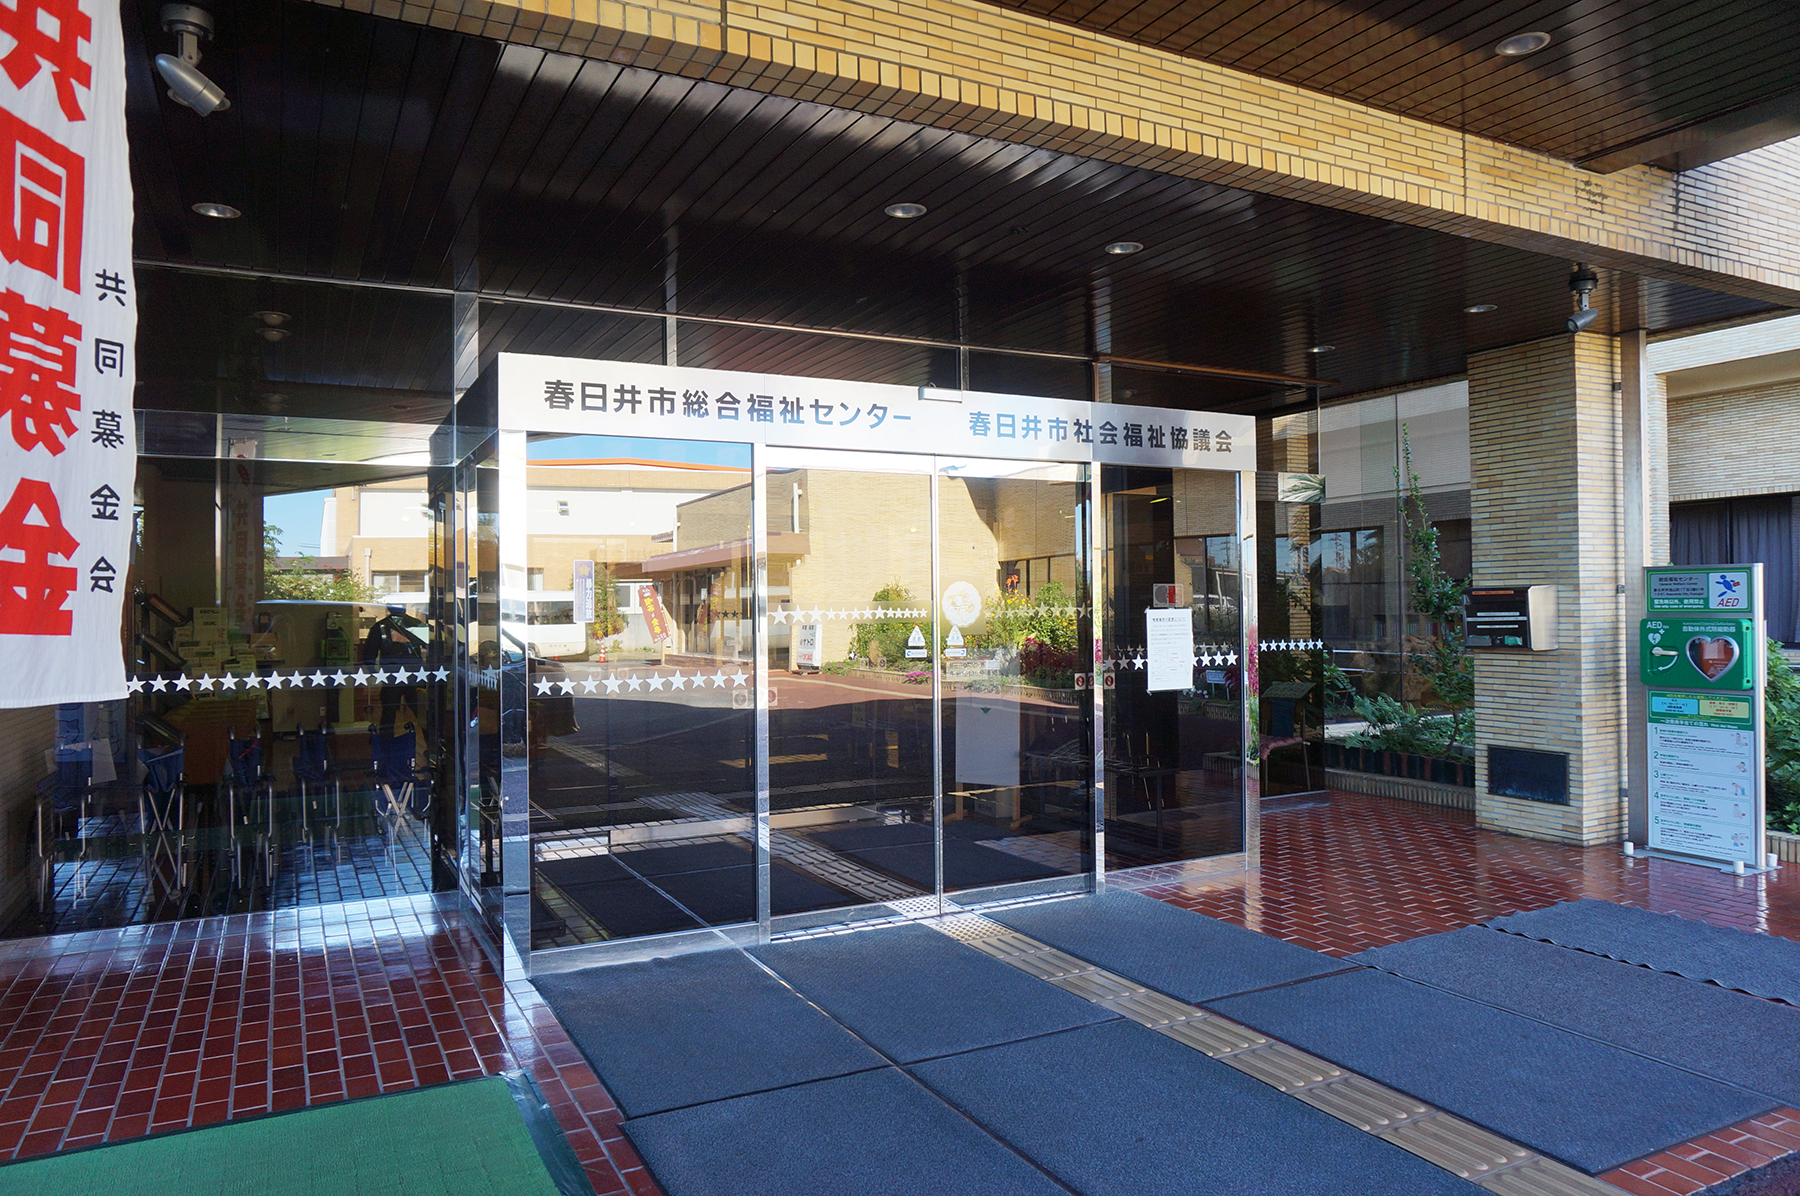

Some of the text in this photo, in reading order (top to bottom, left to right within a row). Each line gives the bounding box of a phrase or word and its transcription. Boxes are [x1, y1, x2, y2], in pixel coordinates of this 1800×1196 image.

[544, 379, 912, 429] 春日井市総合福祉センター
[90, 268, 127, 594] 共同募金会
[969, 411, 1233, 454] 春日井市社会福祉協議会
[1717, 598, 1740, 607] AED
[1646, 621, 1663, 629] AED
[1653, 726, 1658, 734] 1
[1653, 751, 1659, 759] 2
[1653, 770, 1659, 778] 3
[1653, 791, 1660, 799] 4
[1653, 816, 1660, 825] 5
